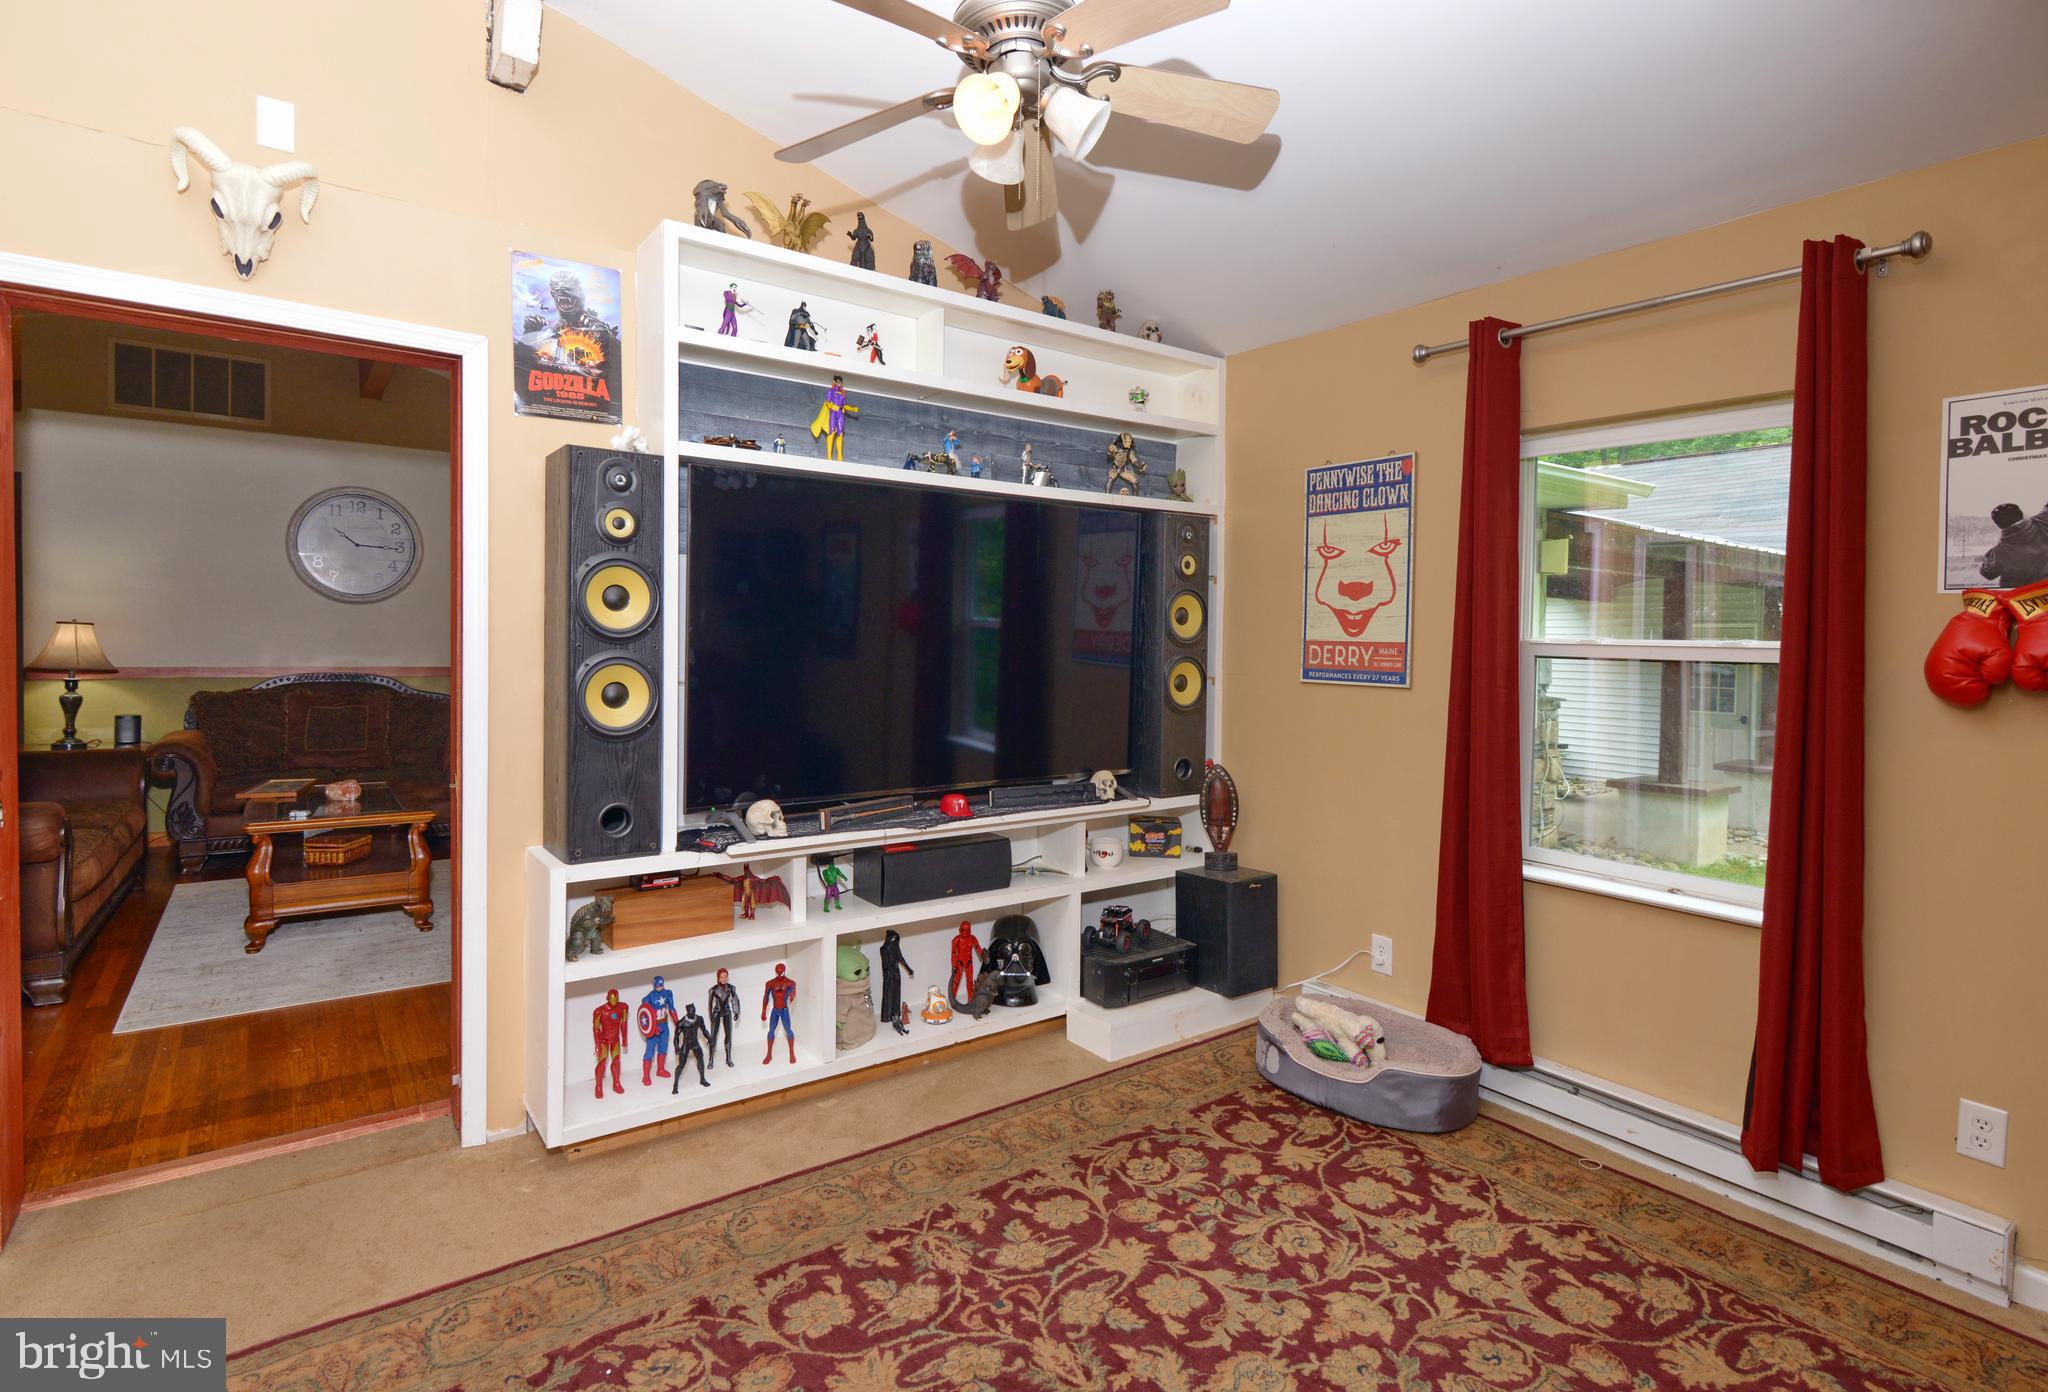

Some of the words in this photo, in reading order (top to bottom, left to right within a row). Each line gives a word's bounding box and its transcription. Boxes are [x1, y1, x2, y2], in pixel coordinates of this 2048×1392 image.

[528, 369, 611, 401] GODZILLA
[1309, 464, 1375, 491] PENNYWISE
[1376, 460, 1403, 483] THE
[1308, 489, 1360, 514] DANCING
[1362, 484, 1409, 508] CLOWN
[350, 500, 367, 514] 12
[377, 508, 384, 520] 1
[391, 522, 402, 536] 2
[388, 559, 399, 572] 4
[1309, 644, 1374, 667] DERRY
[1308, 671, 1352, 680] PERFORMANCES
[1353, 673, 1371, 681] EVERY
